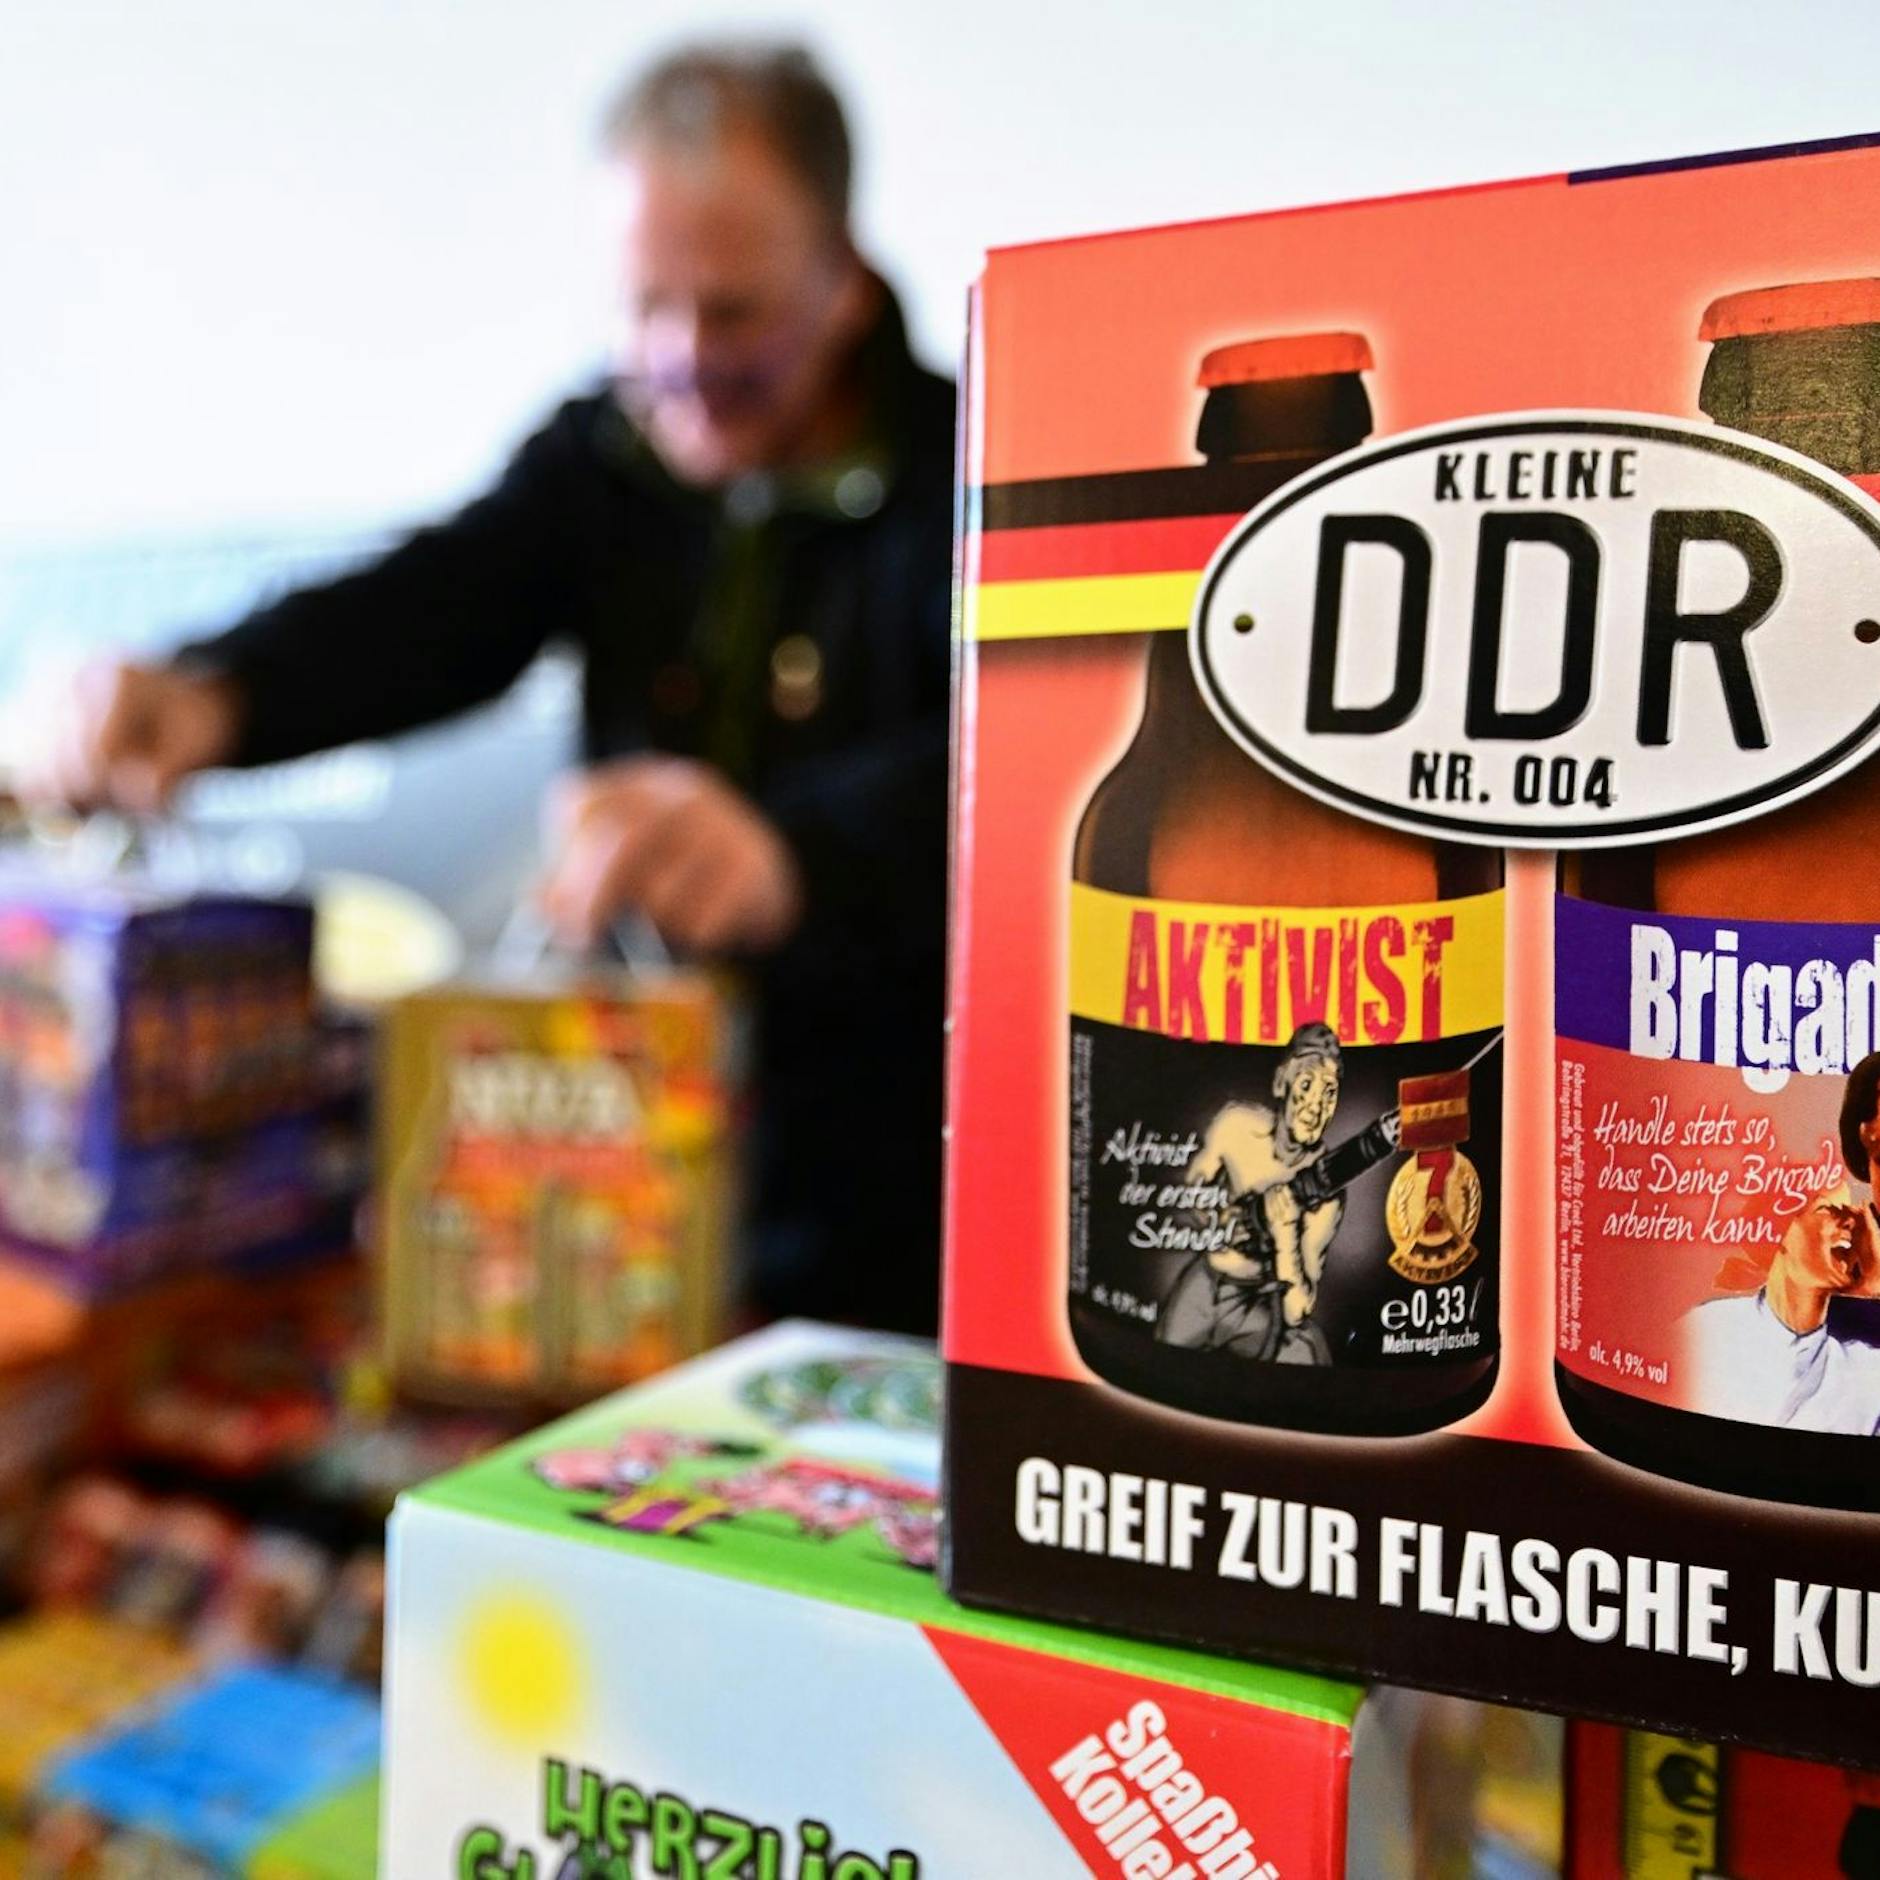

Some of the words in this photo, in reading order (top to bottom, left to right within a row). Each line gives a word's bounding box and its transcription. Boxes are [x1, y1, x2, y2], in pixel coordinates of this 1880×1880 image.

[1434, 449, 1638, 500] KLEINE
[1306, 509, 1785, 750] DDR
[1409, 751, 1490, 803] NR.
[1514, 755, 1619, 809] 004
[1123, 910, 1454, 1045] AKTIVIST
[1594, 1095, 1675, 1146] Handle
[1680, 1104, 1735, 1147] stets
[1742, 1117, 1776, 1151] so,
[1599, 1144, 1642, 1192] dass
[1647, 1152, 1728, 1196] Deine
[1736, 1140, 1843, 1215] Brigade
[1602, 1199, 1695, 1242] arbeiten
[1701, 1192, 1783, 1244] kann.
[1381, 1326, 1481, 1357] Mehrwegflasche
[1589, 1340, 1609, 1366] alc.
[1612, 1349, 1645, 1378] 4,9%
[1647, 1361, 1668, 1384] vol
[1015, 1457, 1207, 1570] GREIF
[1217, 1490, 1358, 1600] ZUR
[1379, 1515, 1749, 1677] FLASCHE,
[1773, 1578, 1880, 1688] KU
[1048, 1733, 1198, 1880] Kolle
